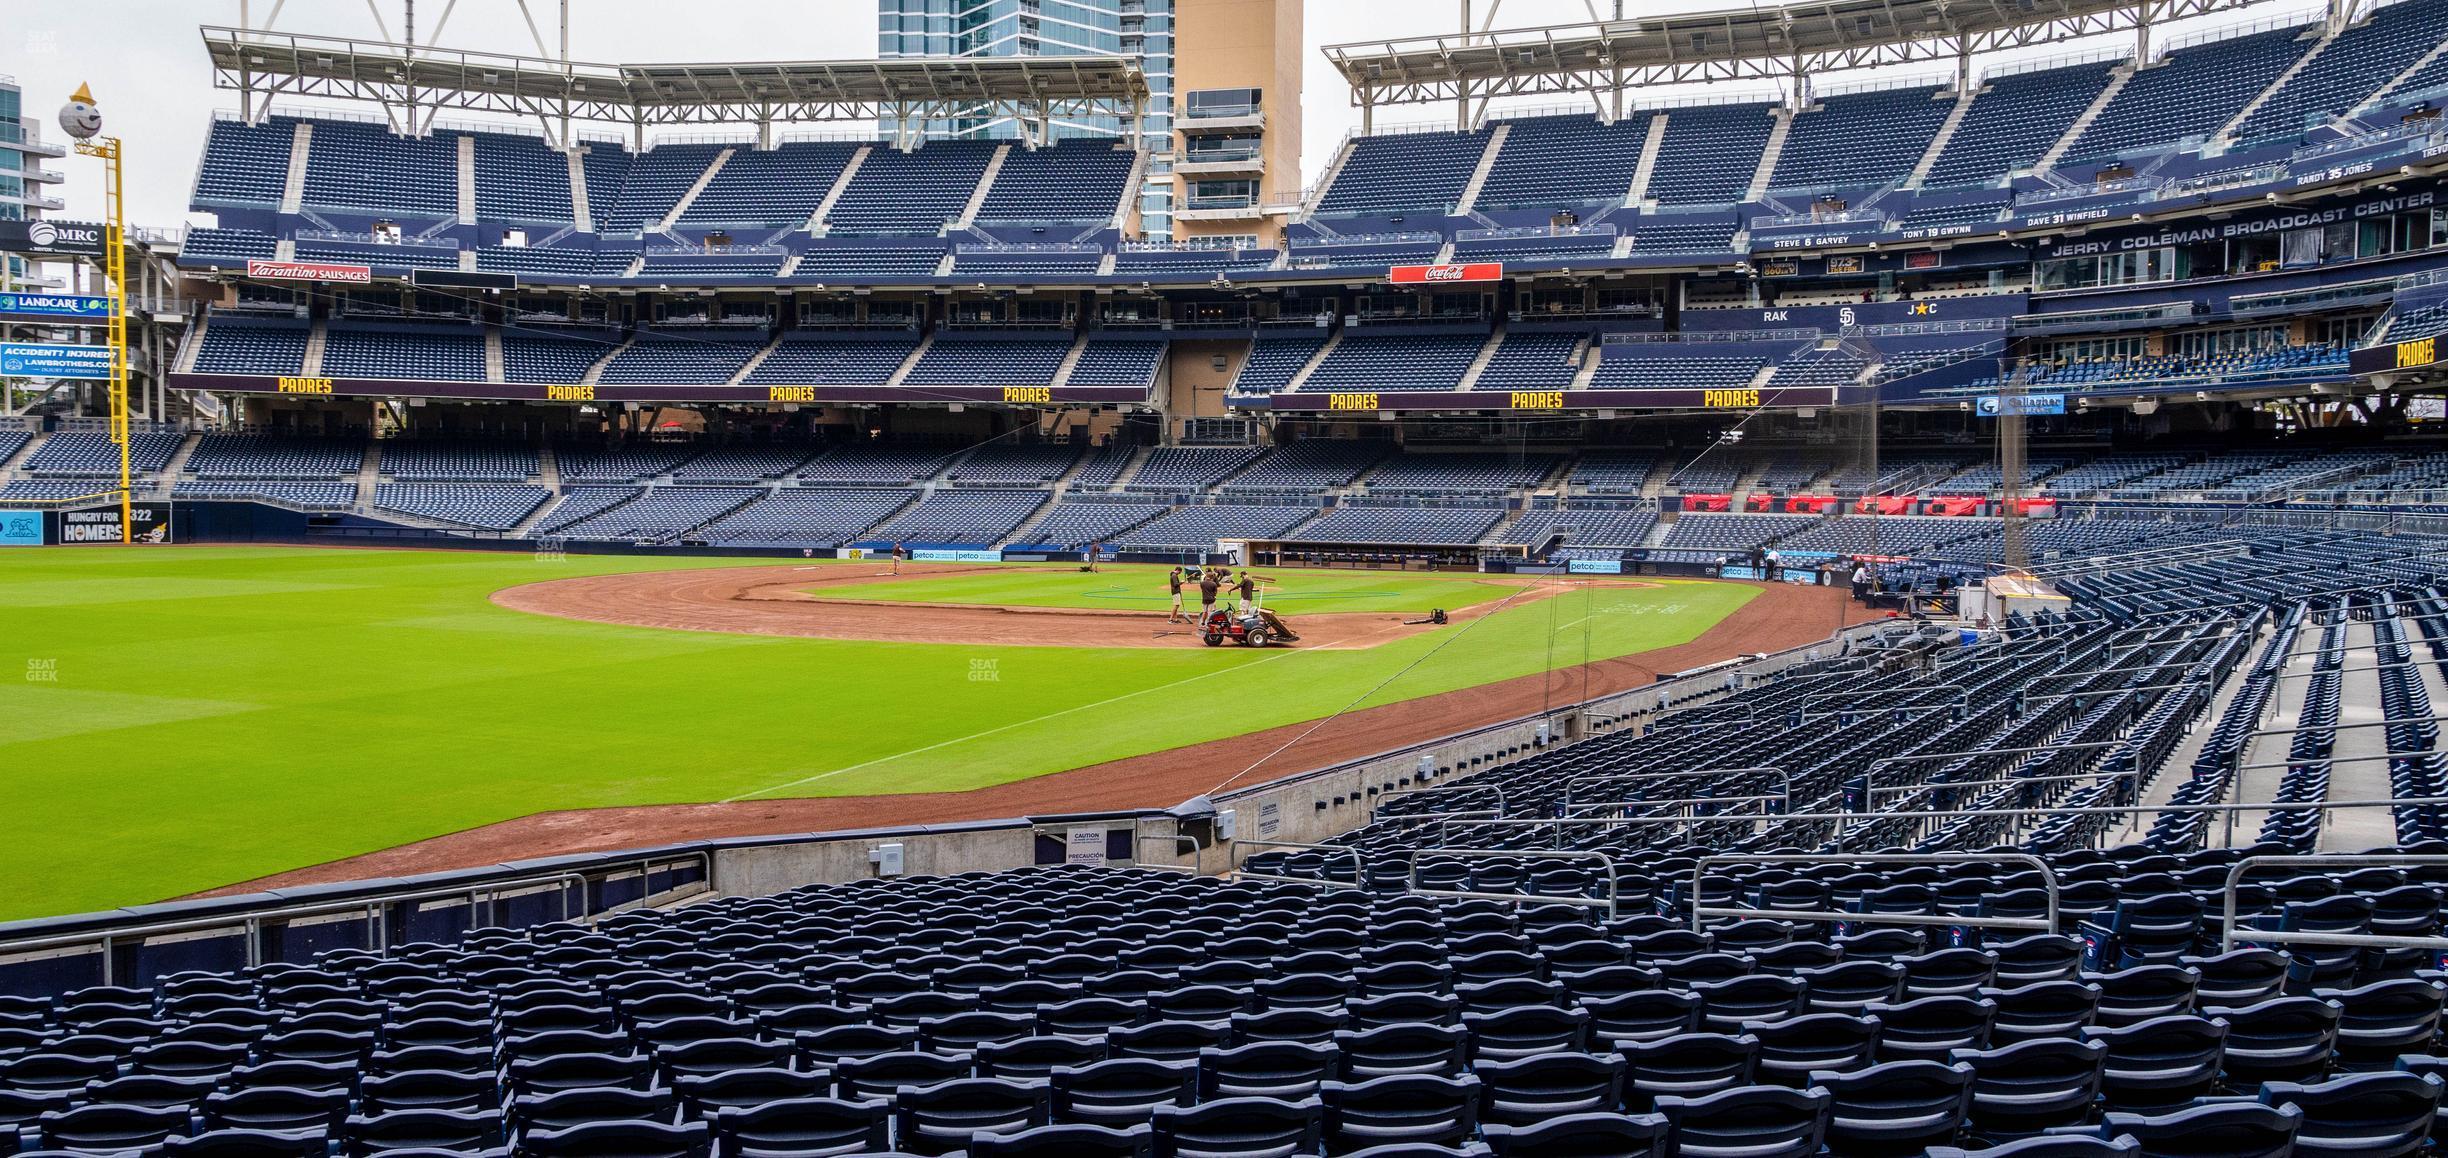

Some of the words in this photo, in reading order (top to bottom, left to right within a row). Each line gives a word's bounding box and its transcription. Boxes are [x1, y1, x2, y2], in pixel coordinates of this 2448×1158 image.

[2297, 172, 2326, 186] RANDY
[2328, 168, 2343, 180] 35
[2344, 163, 2374, 176] JONES
[2027, 216, 2050, 227] DAVE
[2052, 214, 2064, 224] 31
[2066, 209, 2109, 222] WINFIELD
[2052, 240, 2113, 257] JERRY
[2121, 227, 2216, 250] COLEMAN
[2223, 207, 2348, 237] BROADCAST
[2354, 191, 2435, 217] CENTER
[57, 228, 98, 242] MRC
[1902, 229, 1925, 239] TONY
[1927, 226, 1939, 237] 19
[1941, 223, 1972, 236] GWYNN
[1774, 239, 1801, 248] STEVE
[1804, 237, 1812, 247] 6
[1815, 234, 1850, 246] GARVEY
[251, 262, 317, 278] Tarantino
[318, 270, 369, 281] SAUSAGES
[19, 297, 79, 309] LANDCARE
[82, 300, 119, 310] LOGC
[1763, 310, 1789, 323] RAK
[4, 348, 65, 357] ACCIDENT?
[66, 350, 117, 359] INJURED?
[2397, 338, 2435, 368] PADRES
[277, 376, 333, 395] PADRES
[548, 385, 595, 401] PADRES
[769, 385, 815, 402] PADRES
[1003, 386, 1050, 404] PADRES
[1329, 393, 1378, 411] PADRES
[1511, 391, 1563, 409] PADRES
[1704, 389, 1760, 408] PADRES
[68, 512, 101, 522] HUNGRY
[102, 512, 119, 522] FOR
[130, 509, 152, 521] 322
[64, 524, 123, 541] HOMERS
[1571, 563, 1595, 571] petco
